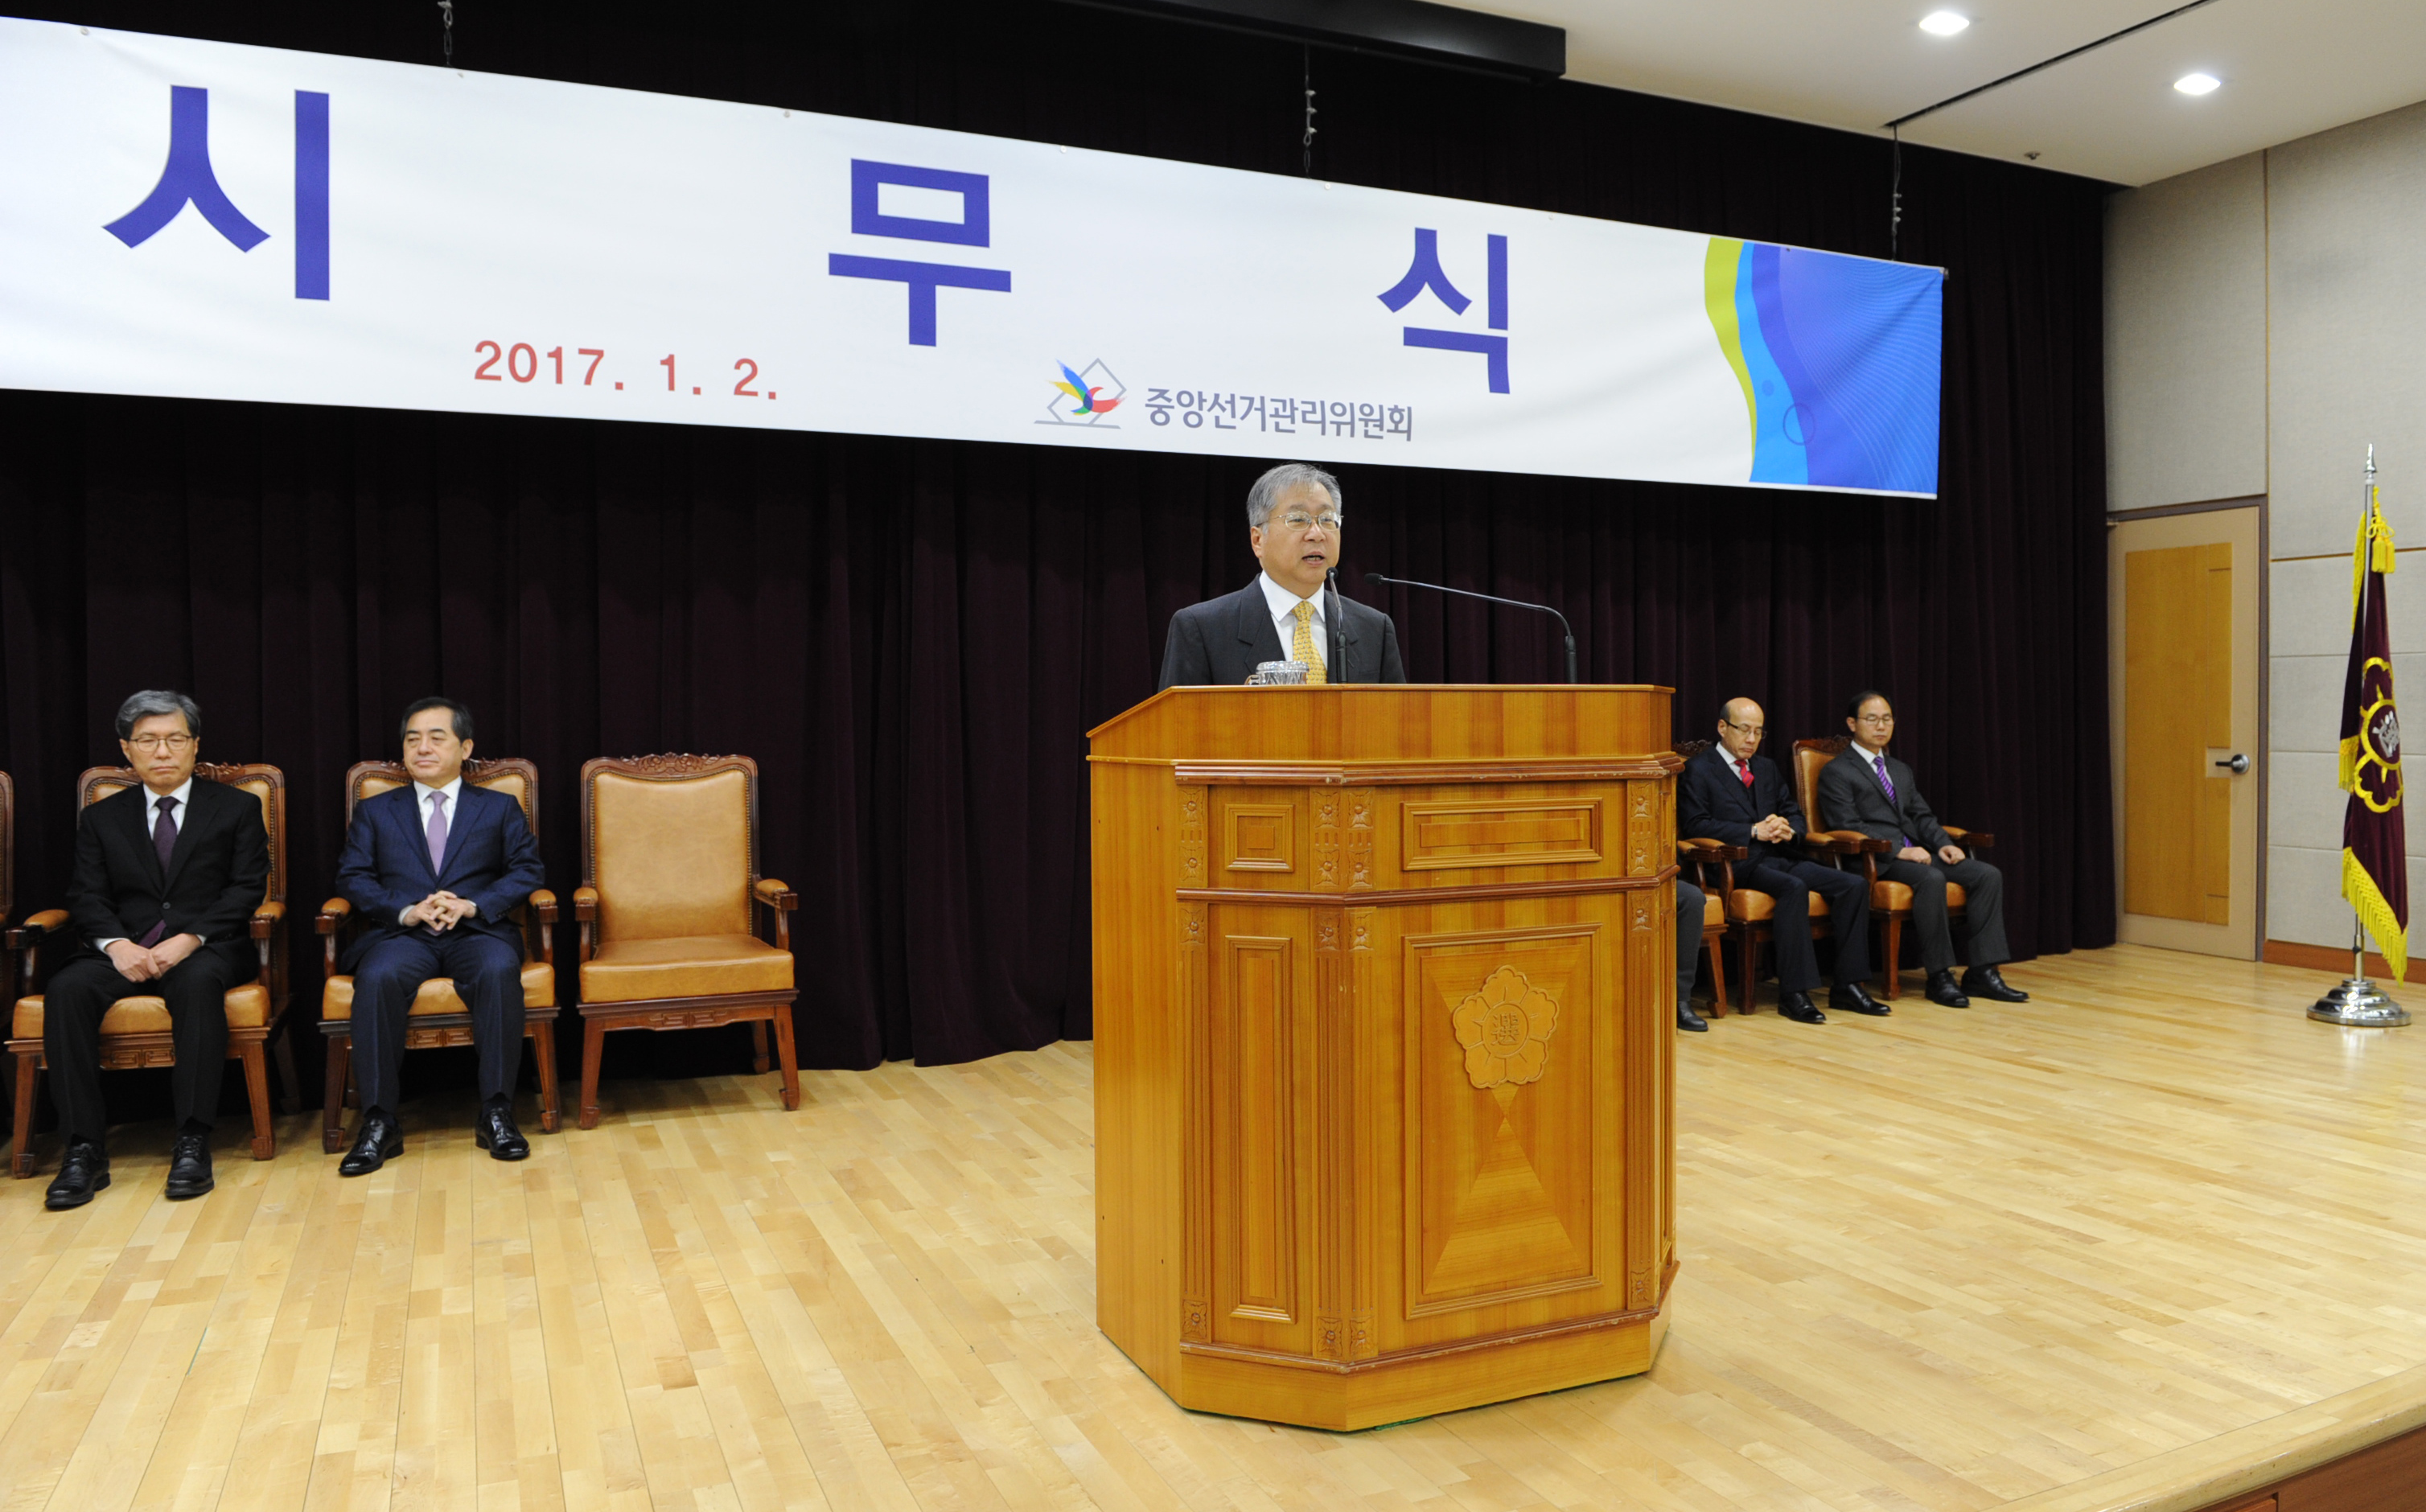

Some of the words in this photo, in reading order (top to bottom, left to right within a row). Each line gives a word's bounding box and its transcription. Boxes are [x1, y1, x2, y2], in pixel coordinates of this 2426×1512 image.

[103, 84, 331, 302] 시
[829, 158, 1012, 347] 무
[1377, 227, 1511, 395] 식
[474, 339, 624, 391] 2017.
[660, 353, 702, 396] 1.
[733, 357, 777, 401] 2.
[1145, 388, 1413, 442] 중앙선거관리위원회
